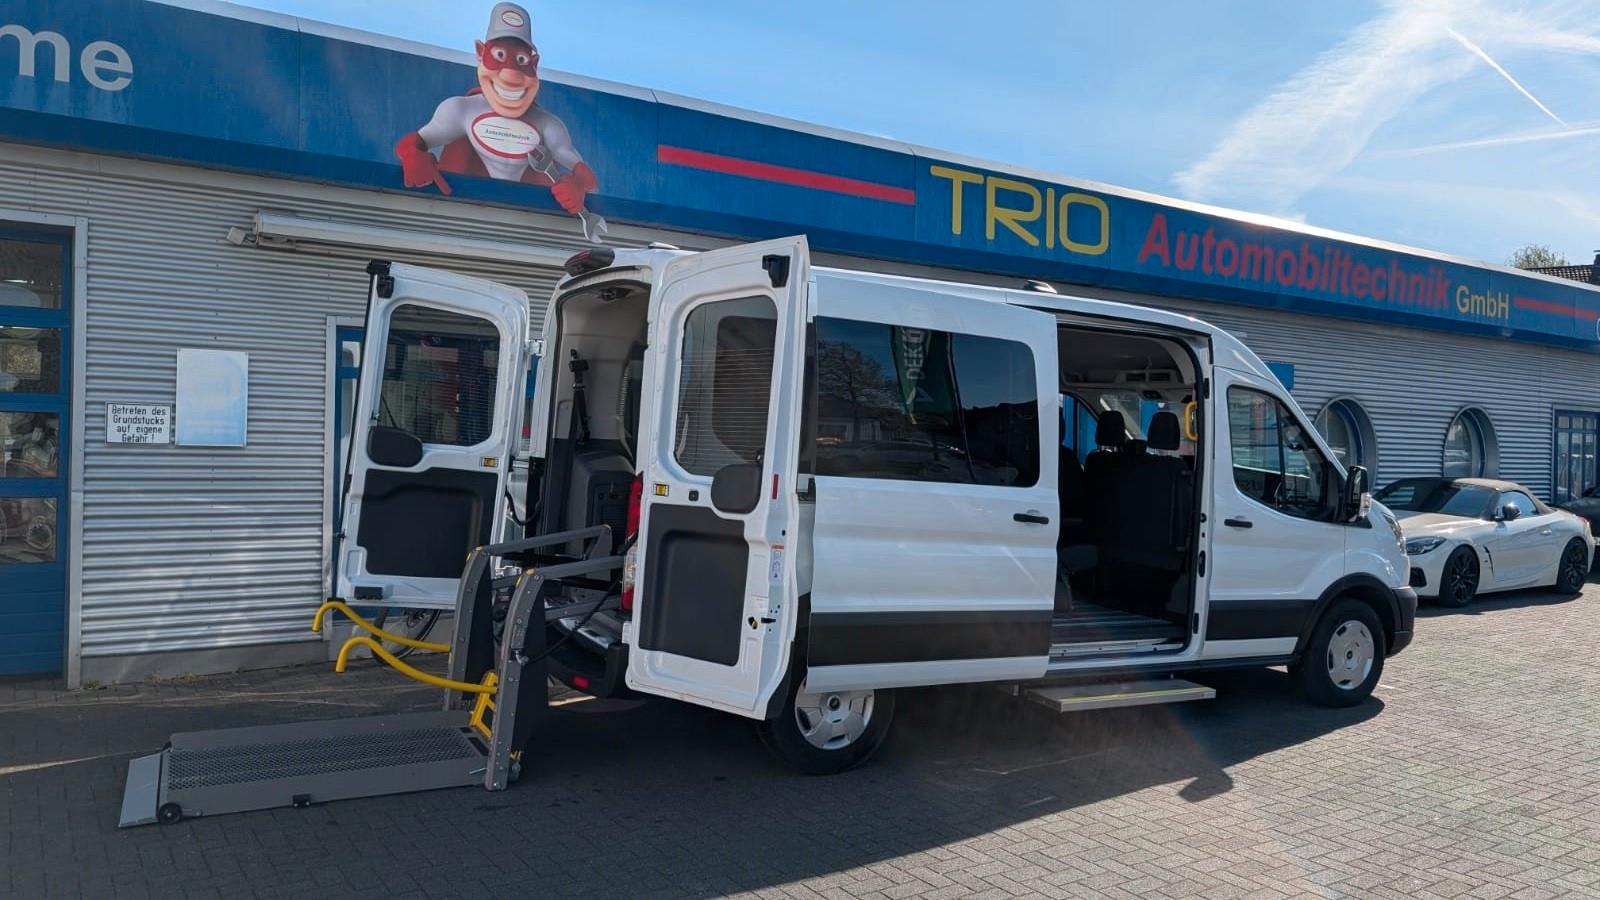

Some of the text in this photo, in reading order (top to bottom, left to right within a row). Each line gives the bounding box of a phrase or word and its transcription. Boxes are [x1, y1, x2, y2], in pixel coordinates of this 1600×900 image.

[930, 165, 1510, 320] TRIO Automobiltechnik GmbH
[111, 404, 167, 416] Betreten des
[116, 424, 163, 436] auf eigene
